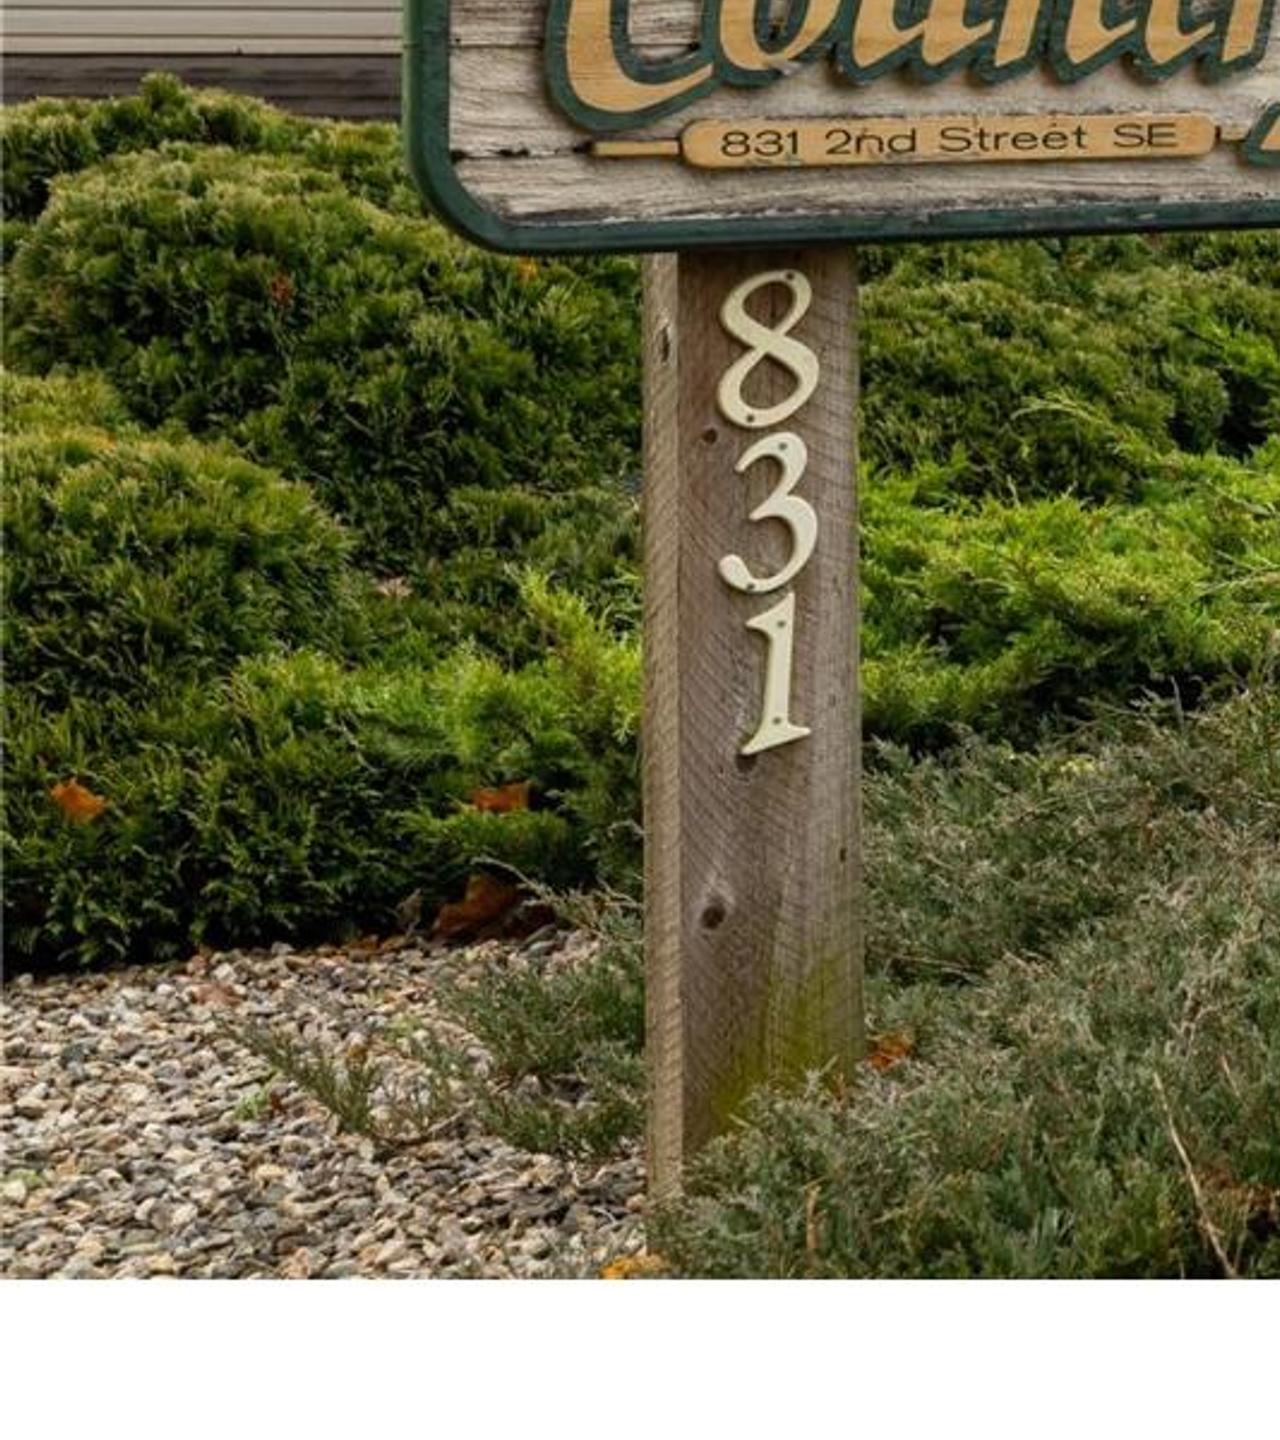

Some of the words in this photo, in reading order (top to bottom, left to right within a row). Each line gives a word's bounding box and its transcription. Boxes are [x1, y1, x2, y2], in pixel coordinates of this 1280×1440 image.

[720, 129, 799, 156] 831
[825, 126, 918, 155] 2nd
[938, 123, 1089, 152] Street
[1112, 121, 1178, 149] SE
[717, 268, 820, 756] 831
